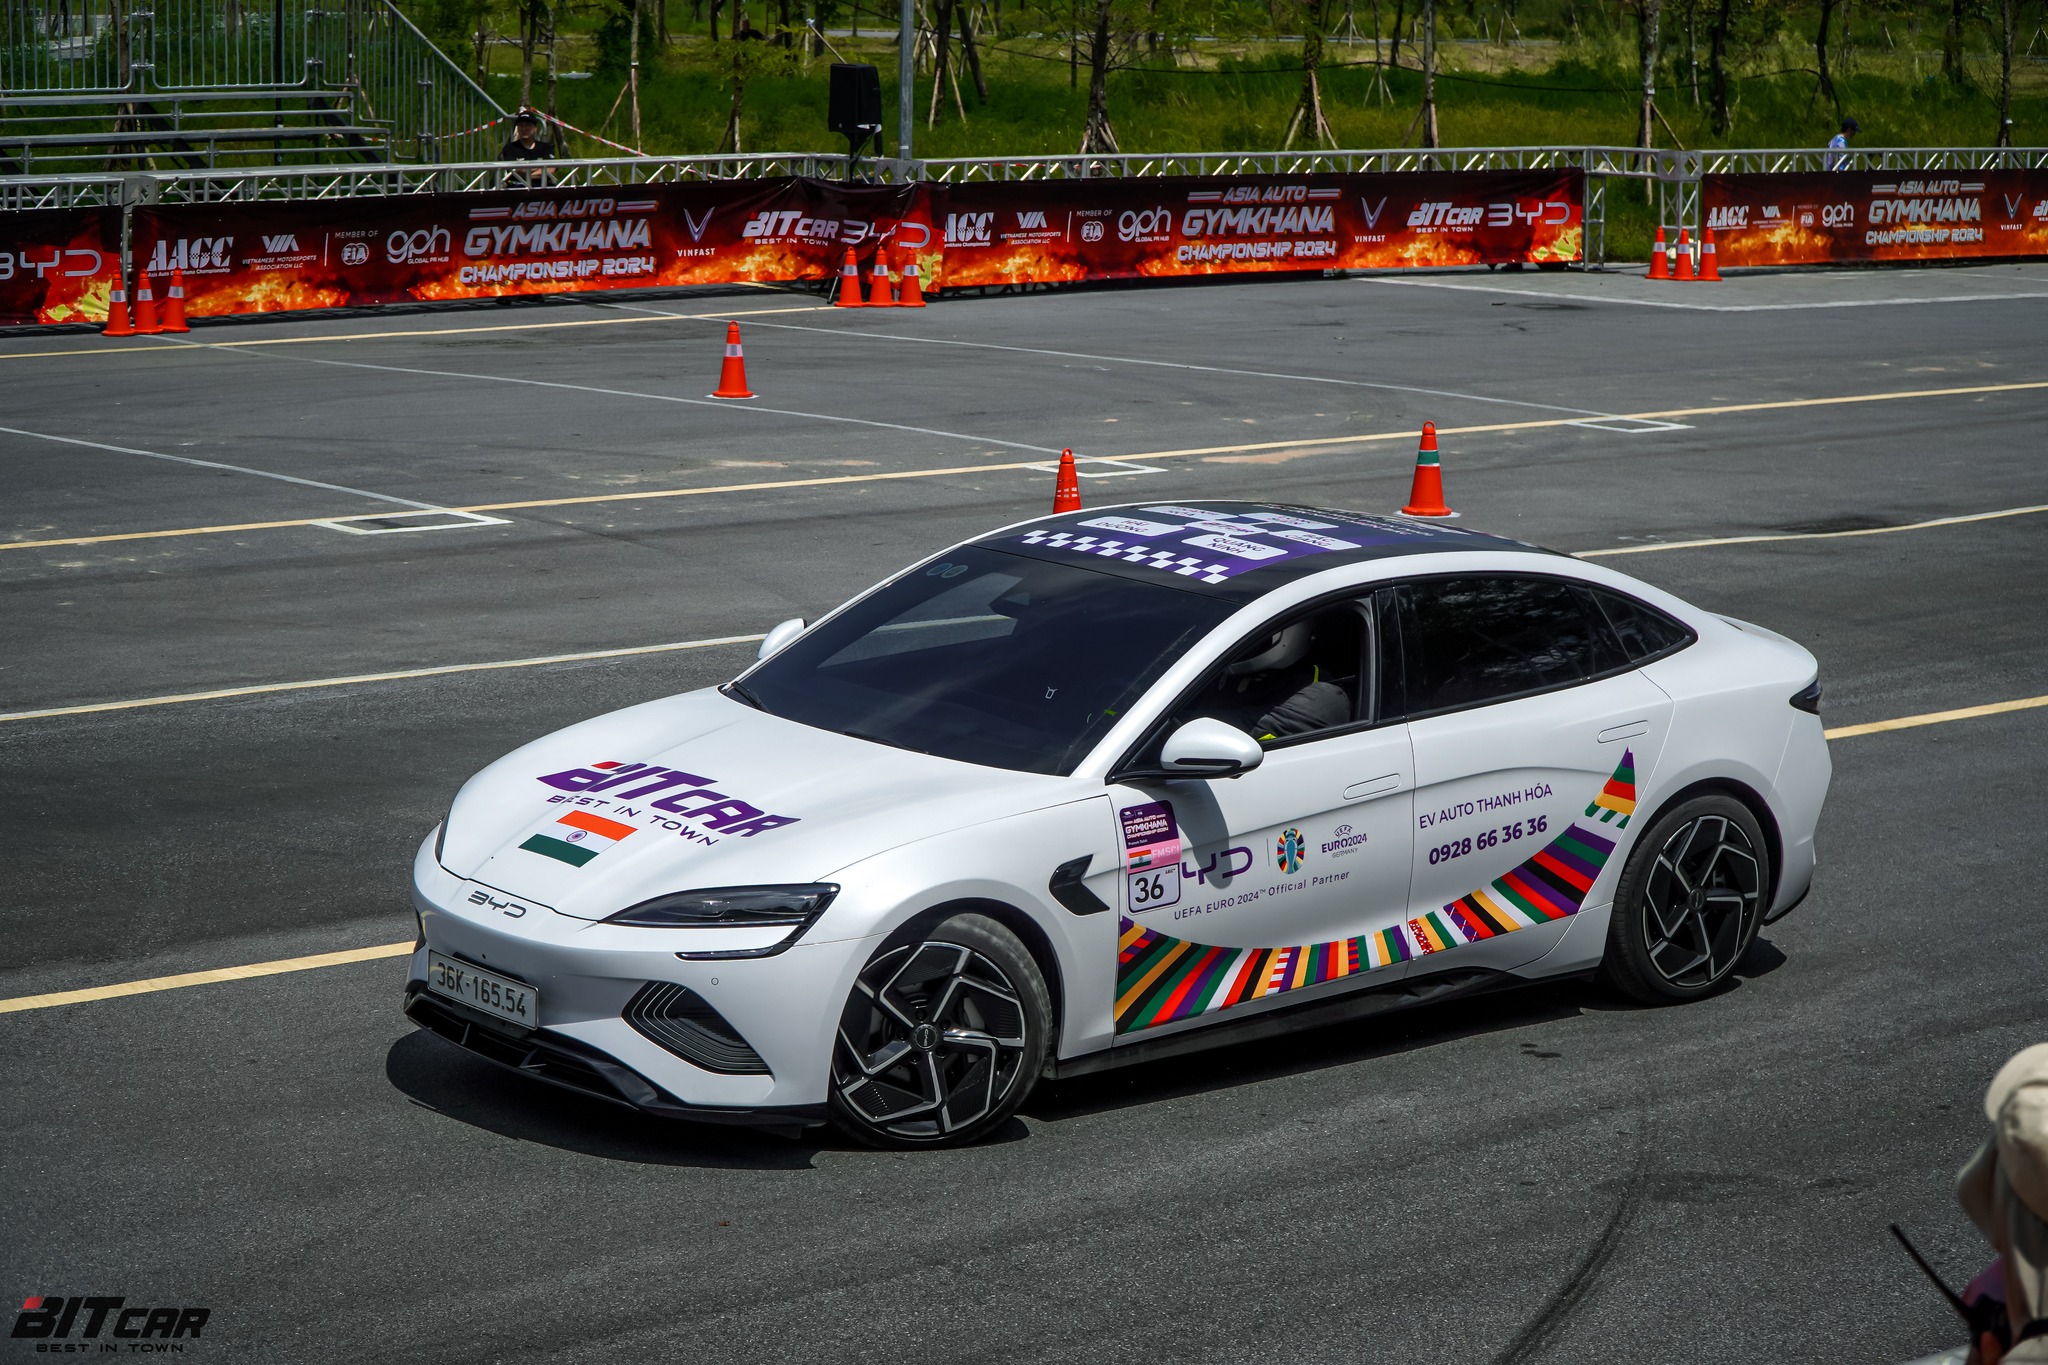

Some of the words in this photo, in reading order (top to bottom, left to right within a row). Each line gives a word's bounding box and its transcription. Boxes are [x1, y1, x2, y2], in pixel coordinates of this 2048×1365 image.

[1223, 187, 1259, 203] ASIA
[1261, 186, 1307, 202] AUTO
[1898, 181, 1924, 194] ASIA
[1926, 180, 1960, 194] AUTO
[512, 201, 556, 219] ASIA
[558, 198, 615, 216] AUTO
[1488, 202, 1570, 226] BYD
[1868, 198, 1981, 224] GYMKHANA
[1082, 223, 1103, 240] FIA
[1118, 206, 1172, 242] gph
[1181, 206, 1335, 236] GYMKHANA
[334, 230, 366, 238] MEMBER
[368, 230, 378, 238] OF
[386, 224, 450, 264] gph
[463, 218, 652, 257] GYMKHANA
[802, 238, 828, 246] TOWN
[1355, 234, 1386, 242] VINFAST
[1866, 229, 1950, 245] CHAMPIONSHIP
[1952, 228, 1984, 242] 2024
[242, 256, 275, 264] VIETNAMESE
[277, 254, 317, 262] MOTORSPORTS
[342, 245, 368, 262] FIA
[677, 247, 716, 257] VINFAST
[1177, 242, 1292, 262] CHAMPIONSHIP
[1294, 240, 1337, 256] 2024
[0, 249, 102, 280] BYD
[256, 262, 293, 271] ASSOCIATION
[459, 259, 600, 284] CHAMPIONSHIP
[602, 256, 656, 276] 2024
[1420, 814, 1436, 829] EV
[1439, 802, 1474, 824] AUTO
[1477, 792, 1521, 813] THANH
[1524, 782, 1552, 802] HÓA
[546, 795, 610, 808] BEST
[614, 805, 642, 818] IN
[649, 815, 720, 846] TOWN
[1126, 819, 1168, 834] GYMKHANA
[1334, 826, 1352, 837] UEFA
[1322, 833, 1367, 854] EURO2024
[1428, 838, 1472, 866] 0928
[1476, 829, 1498, 850] 66
[1502, 822, 1523, 844] 36
[1527, 814, 1548, 836] 36
[1332, 848, 1358, 858] GERMANY
[1182, 846, 1253, 885] YD
[1134, 874, 1164, 903] 36
[1174, 908, 1202, 920] UEFA
[1206, 898, 1234, 914] EURO
[1268, 880, 1307, 896] Official
[1312, 872, 1350, 886] Partner
[468, 890, 526, 918] BYD
[438, 962, 526, 1018] 36K-165.54
